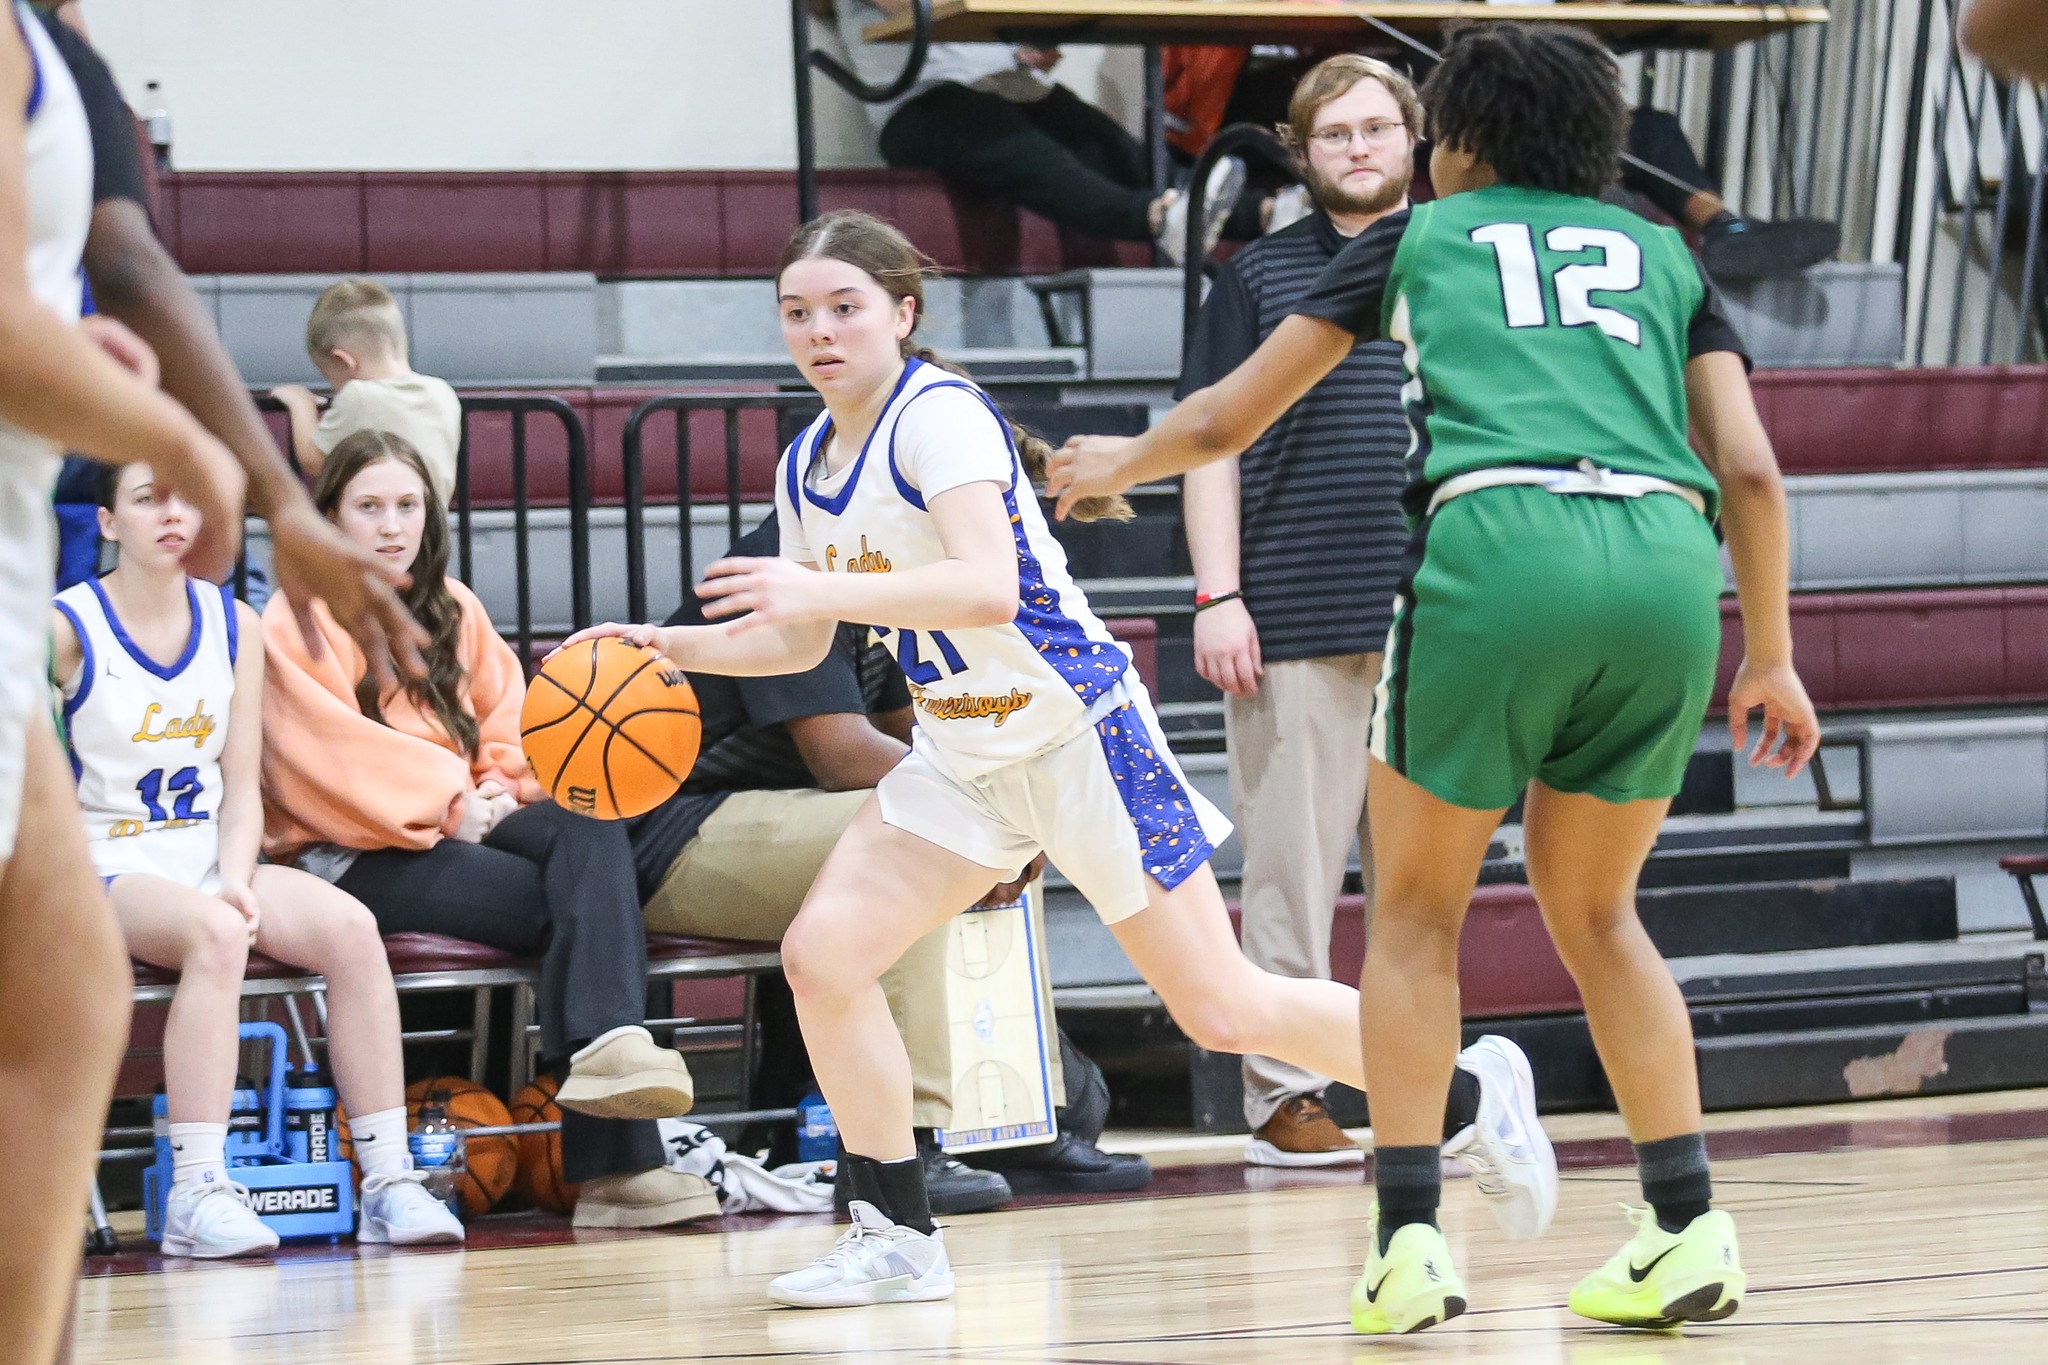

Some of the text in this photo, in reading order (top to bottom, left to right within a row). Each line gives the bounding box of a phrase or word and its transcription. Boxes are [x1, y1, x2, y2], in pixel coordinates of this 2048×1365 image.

[1468, 222, 1643, 348] 12
[871, 626, 970, 686] 21
[131, 699, 217, 749] Lady
[135, 766, 210, 822] 12
[310, 1112, 327, 1163] RADE
[247, 1188, 337, 1212] WERADE
